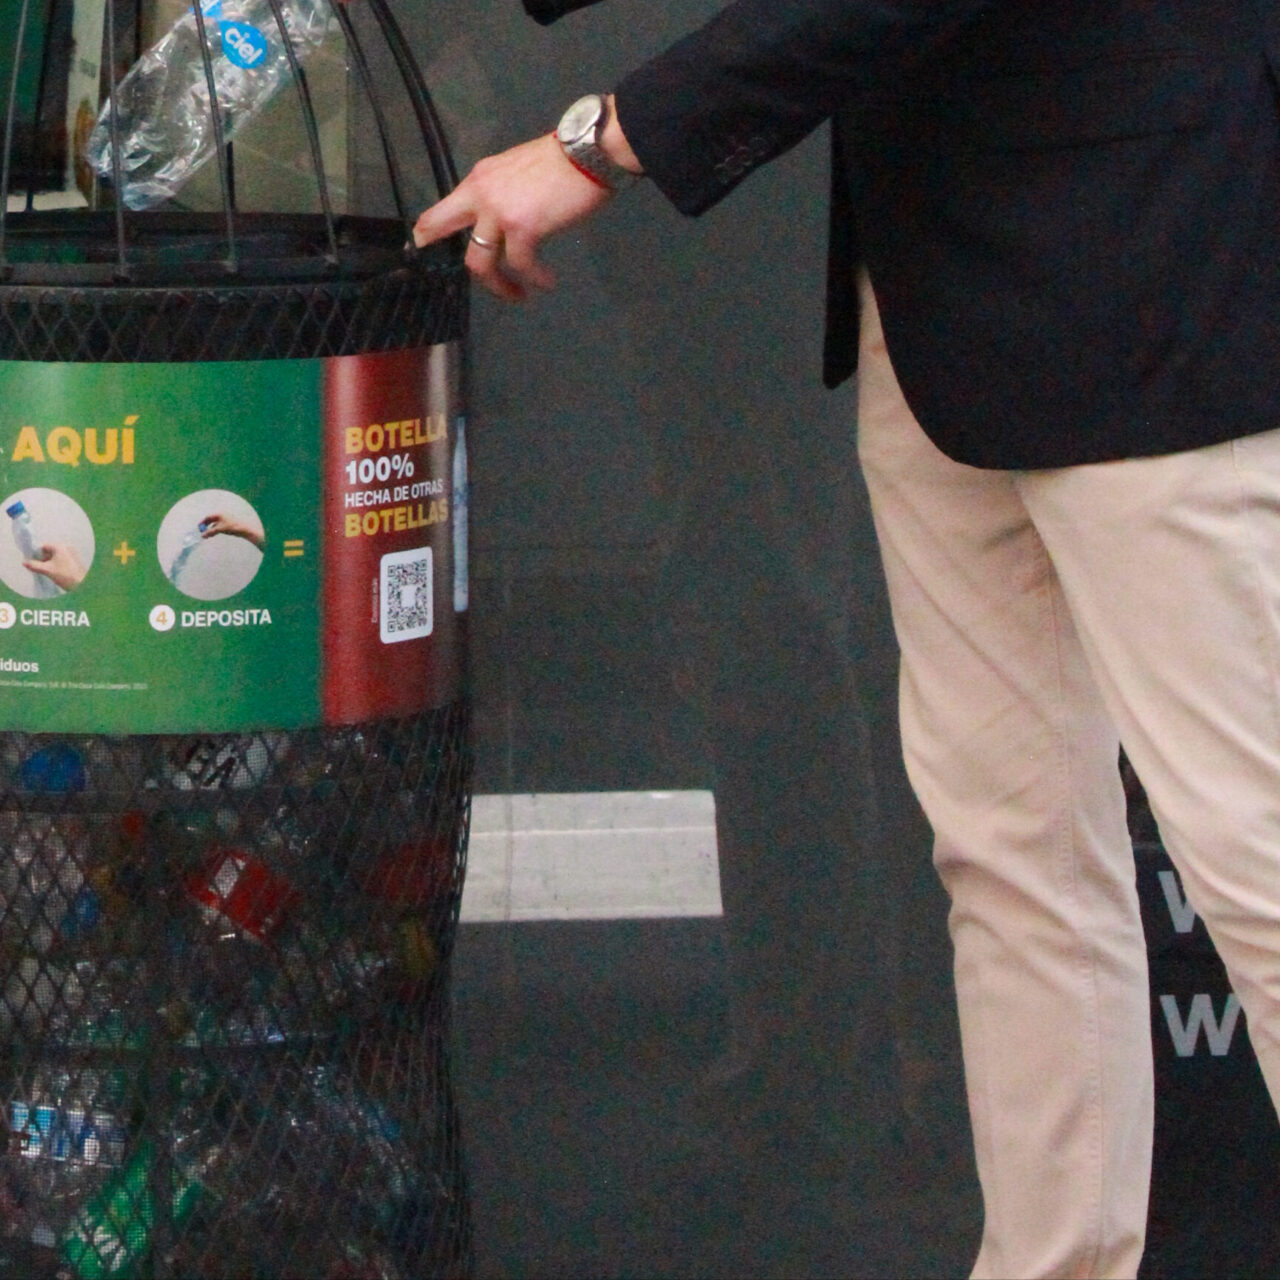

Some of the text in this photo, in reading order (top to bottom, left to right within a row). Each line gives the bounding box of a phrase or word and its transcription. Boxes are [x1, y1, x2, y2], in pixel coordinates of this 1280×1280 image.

[225, 27, 263, 64] ciel
[11, 414, 140, 468] AQUÍ
[345, 452, 415, 485] 100%
[344, 478, 444, 509] HECHA DE OTRAS
[344, 497, 449, 539] BOTELLAS
[20, 609, 90, 628] CIERRA
[181, 608, 273, 628] DEPOSITA
